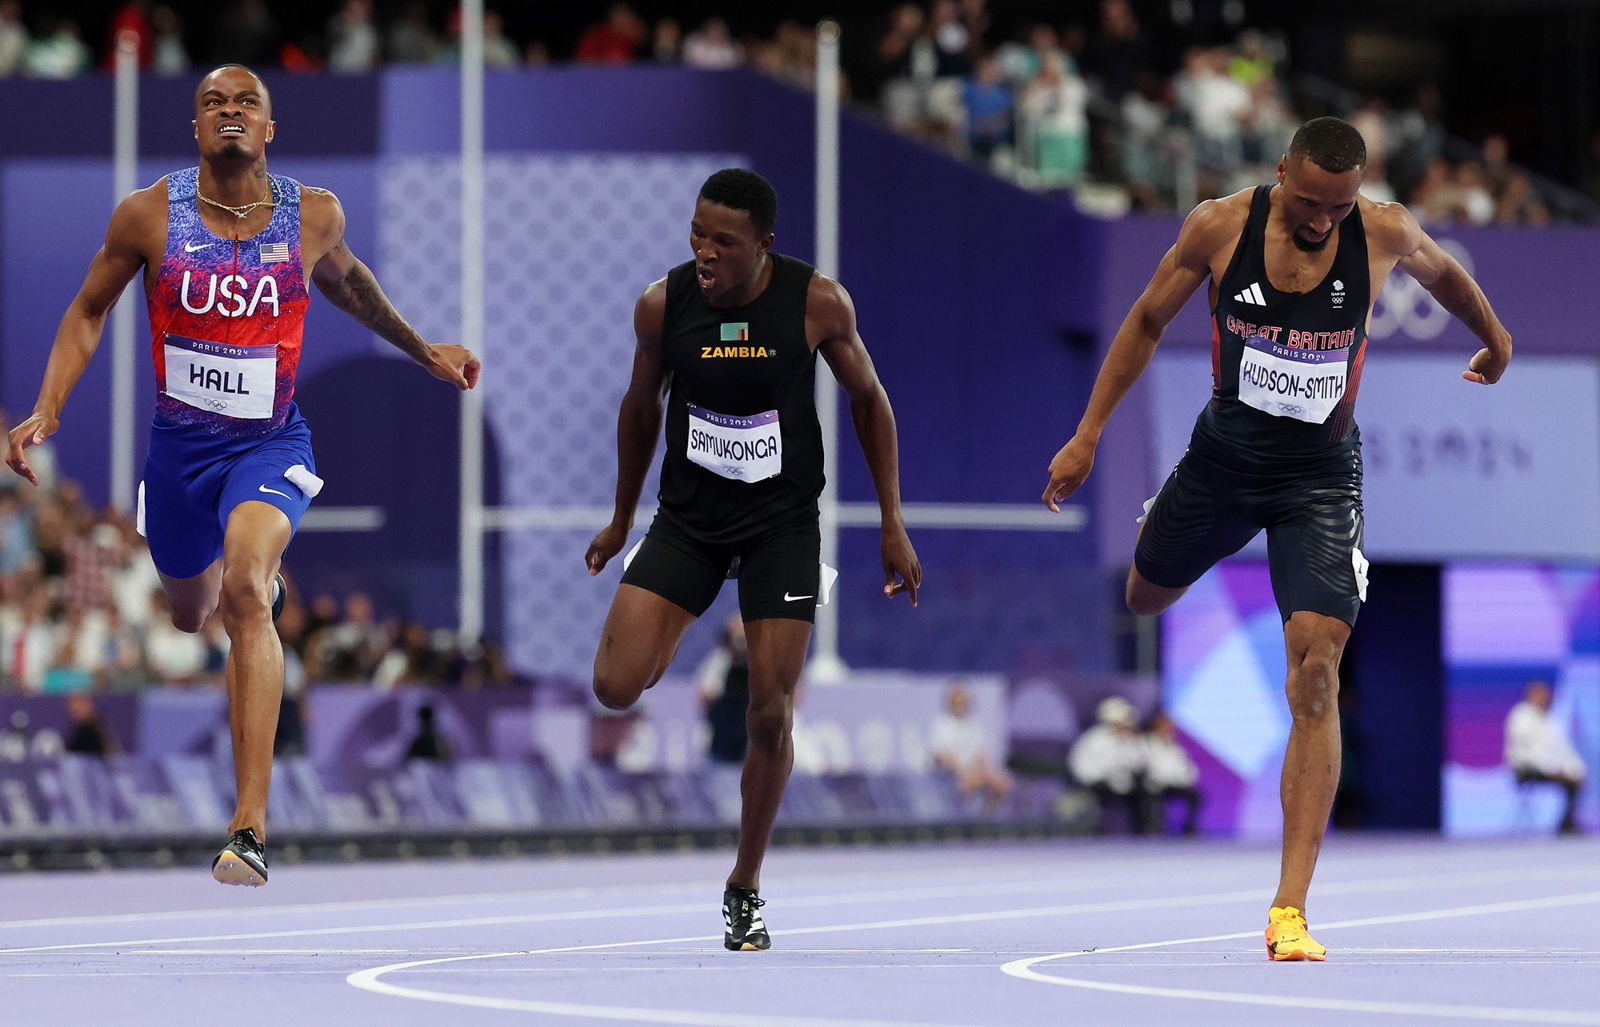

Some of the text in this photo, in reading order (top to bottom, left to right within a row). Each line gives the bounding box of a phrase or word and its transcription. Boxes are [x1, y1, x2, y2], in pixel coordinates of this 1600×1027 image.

[181, 270, 279, 318] USA
[1226, 314, 1356, 350] GREAT BRITAIN
[192, 341, 248, 356] PARIS 2024
[701, 346, 768, 358] ZAMBIA
[1272, 345, 1326, 361] PARIS 2024
[189, 363, 250, 395] HALL
[1243, 360, 1344, 400] HUDSON-SMITH
[706, 413, 753, 427] PARIS 2024
[690, 428, 778, 461] SAMUKONGA
